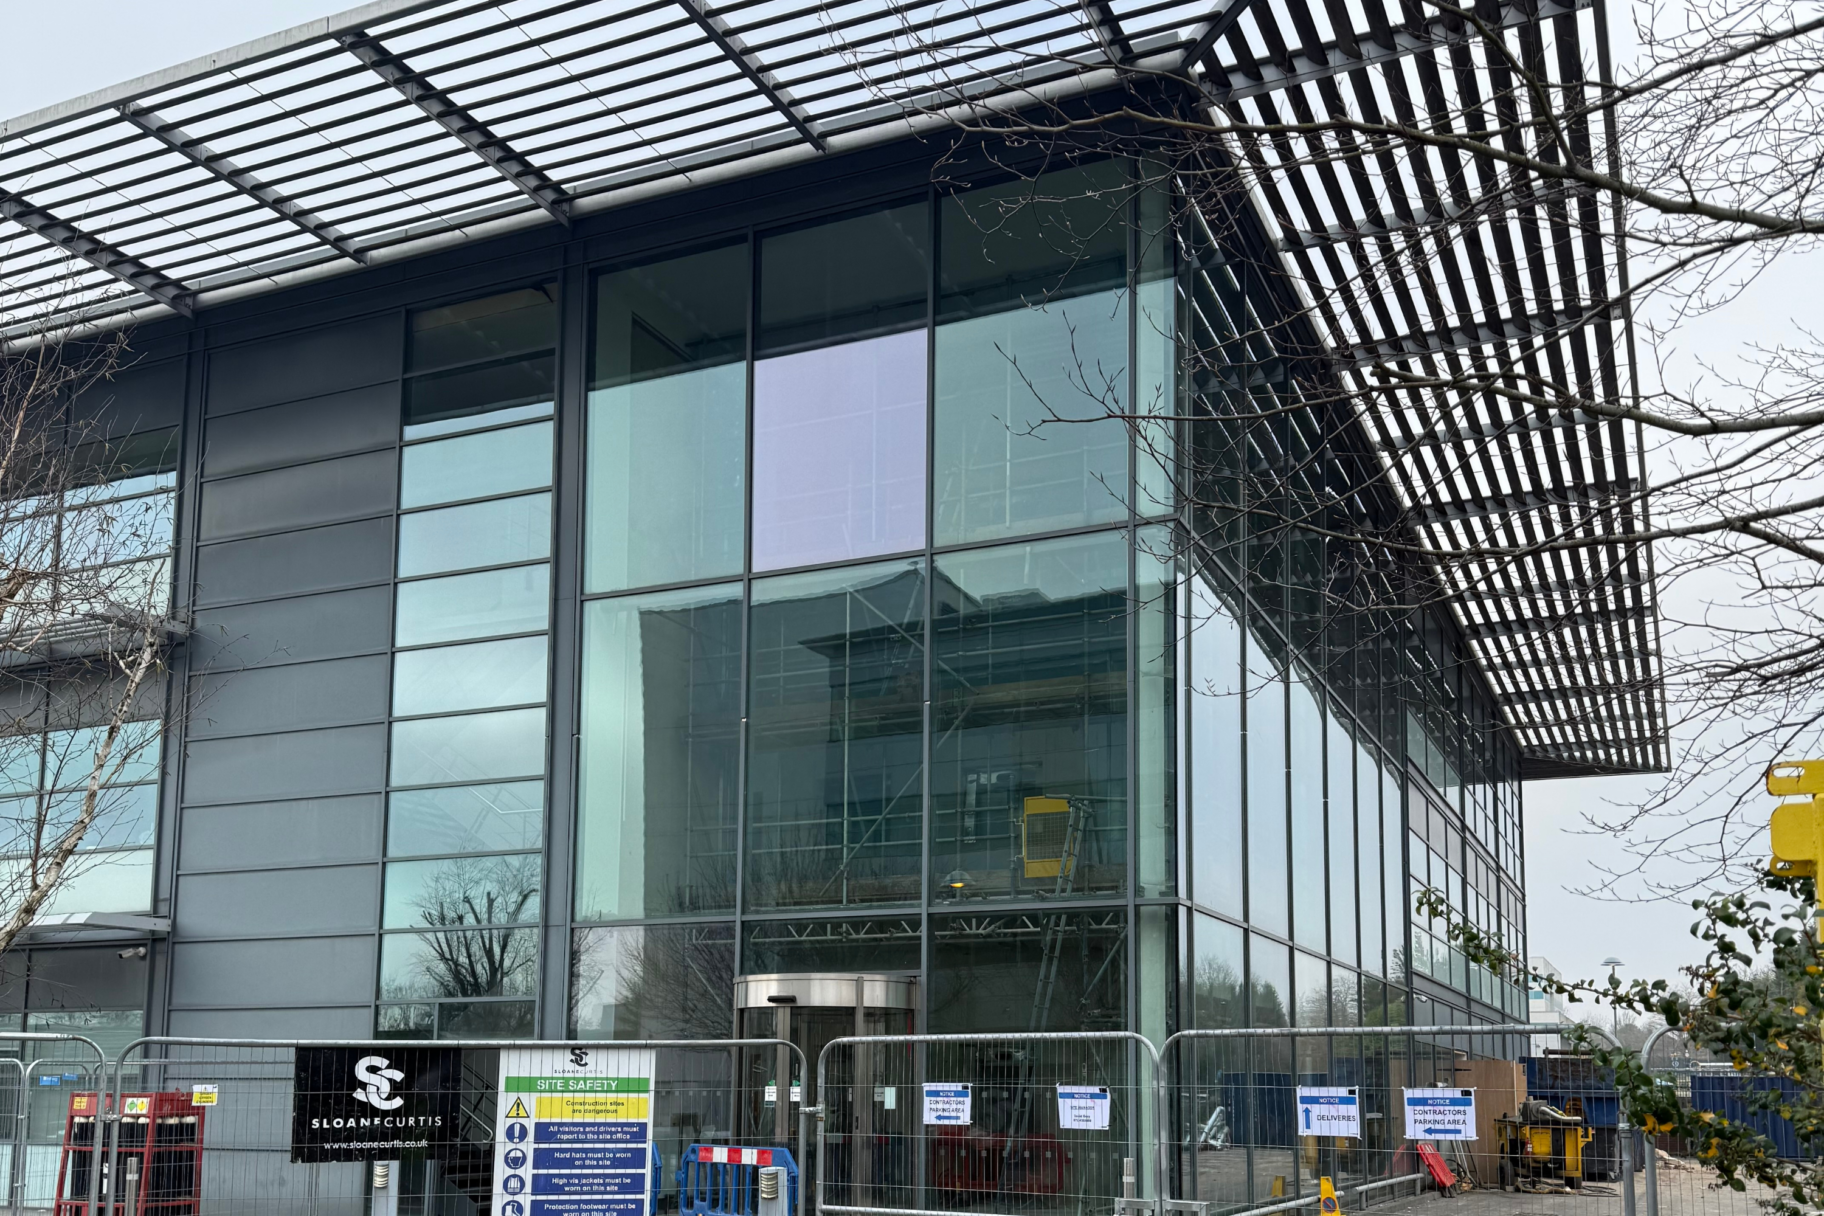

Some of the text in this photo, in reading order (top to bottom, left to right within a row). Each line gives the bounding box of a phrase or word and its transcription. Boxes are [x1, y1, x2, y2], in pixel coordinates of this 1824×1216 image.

[537, 1080, 618, 1090] SITE SAFETY
[324, 1139, 428, 1149] www.sloanecurtis.co.uk
